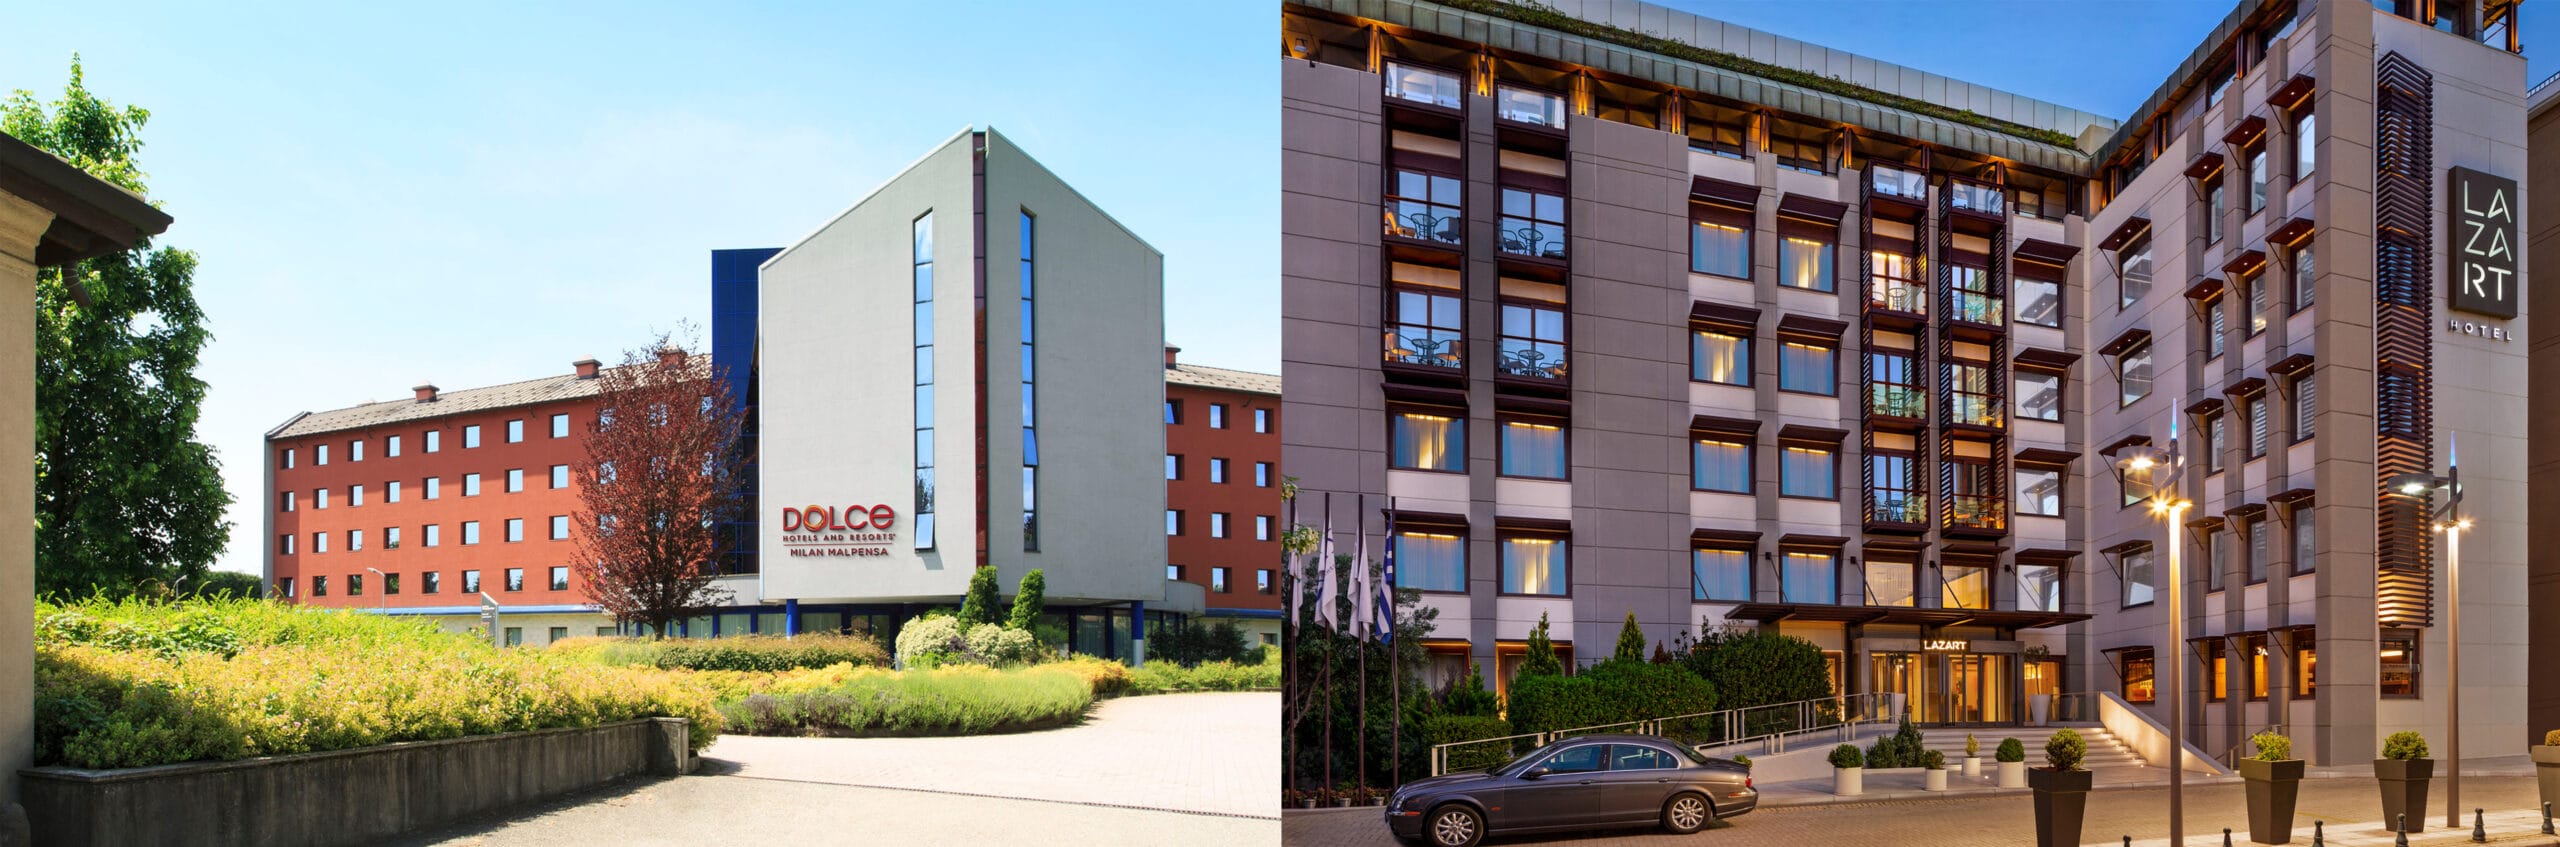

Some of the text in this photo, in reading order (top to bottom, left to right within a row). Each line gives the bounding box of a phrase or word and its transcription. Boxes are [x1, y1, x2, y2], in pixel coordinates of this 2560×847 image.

[2450, 319, 2513, 341] HOTEL
[790, 548, 888, 557] MILAN MALPENSA
[1924, 640, 1967, 650] LAZART
